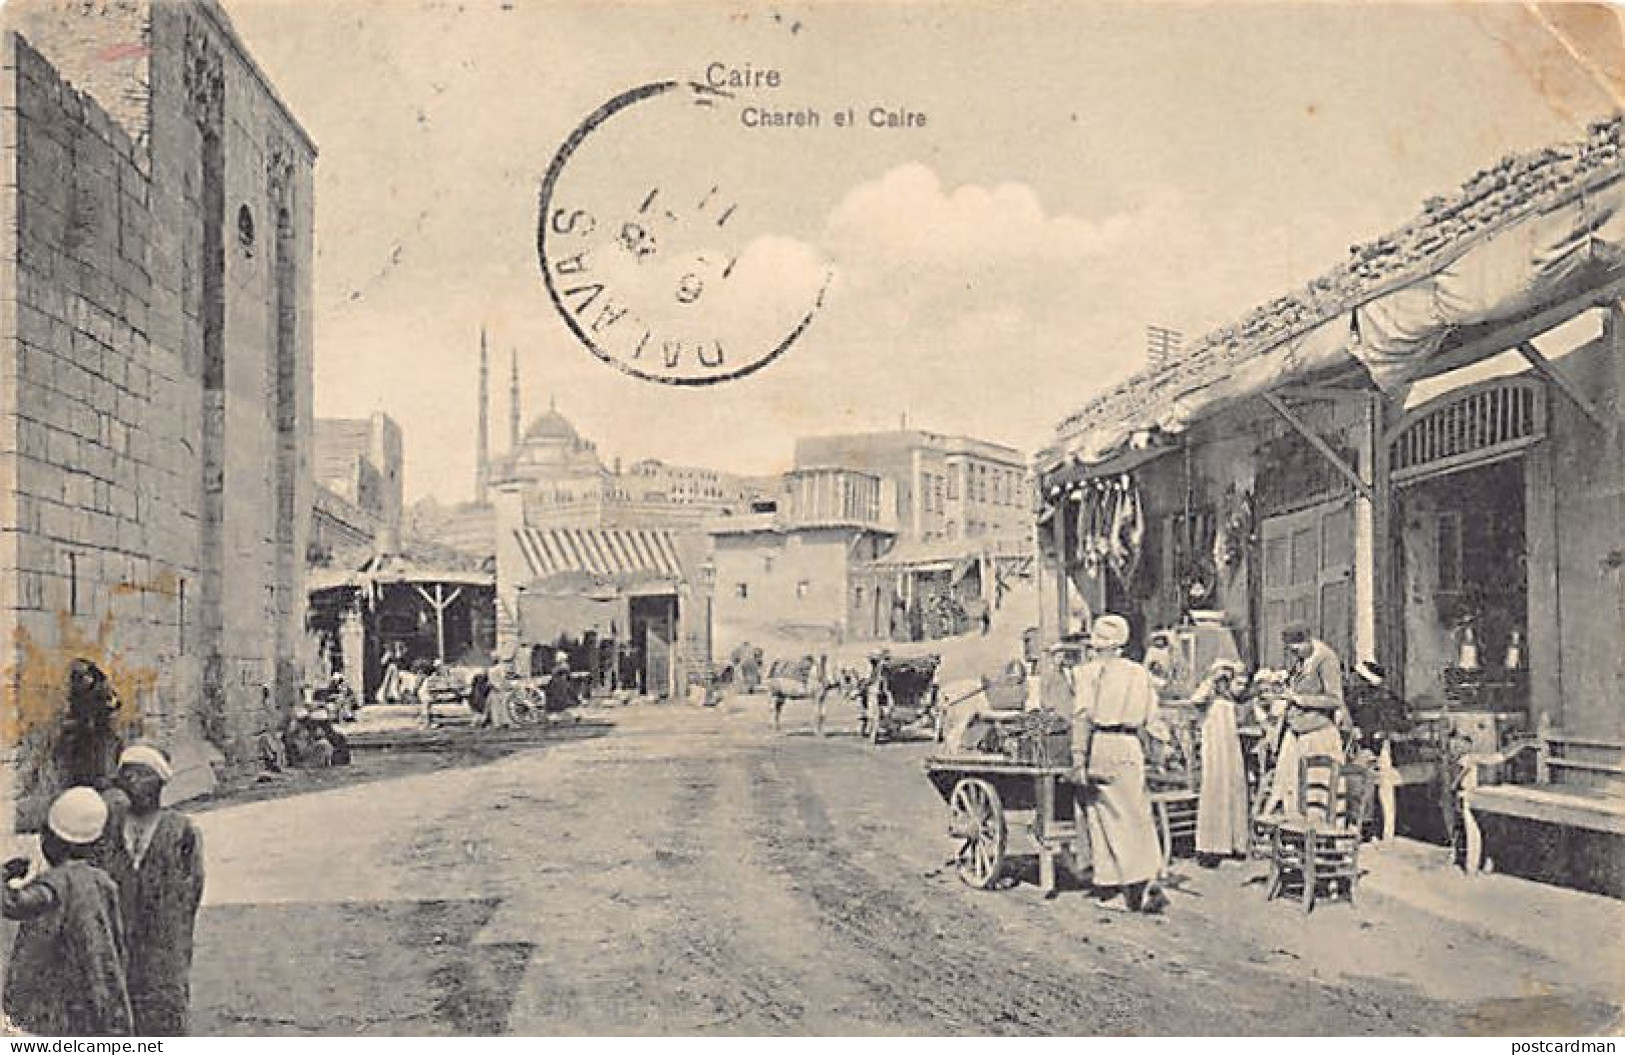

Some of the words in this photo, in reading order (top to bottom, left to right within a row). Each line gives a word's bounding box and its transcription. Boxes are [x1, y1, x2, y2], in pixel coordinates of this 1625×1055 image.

[706, 62, 781, 87] Caire
[741, 107, 820, 127] Chareh
[868, 107, 928, 127] Caire
